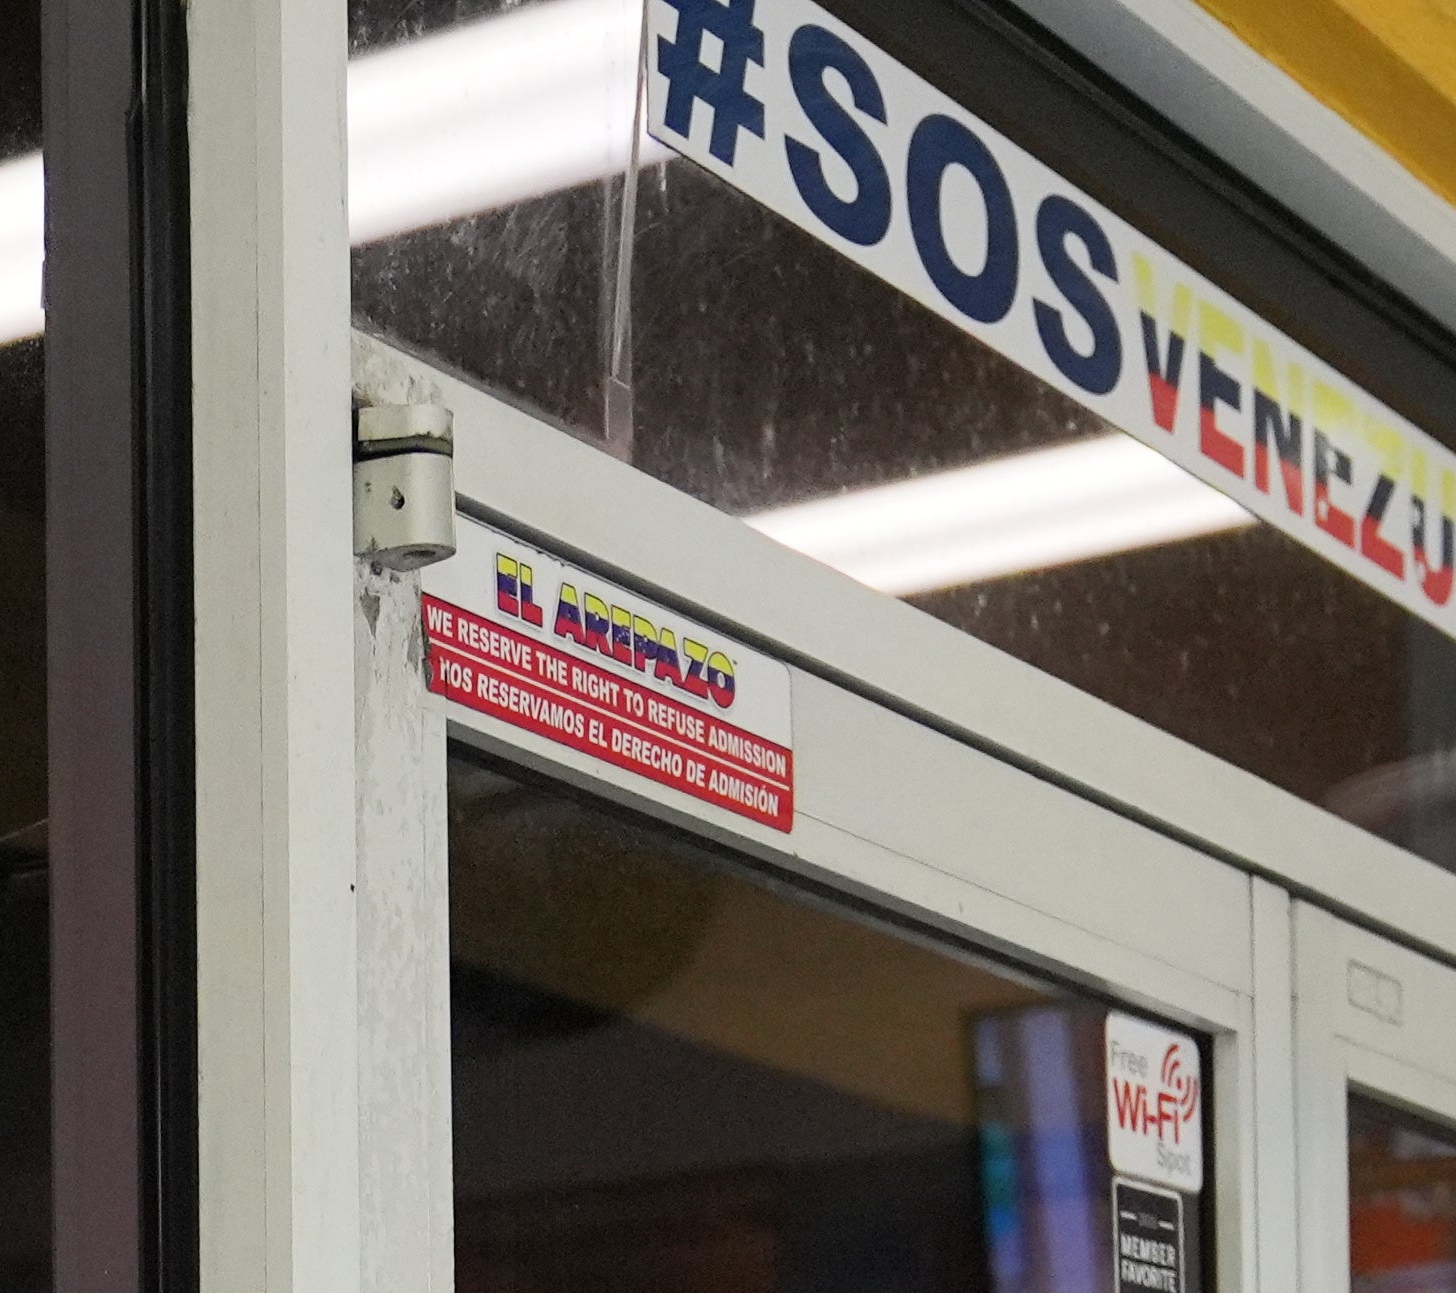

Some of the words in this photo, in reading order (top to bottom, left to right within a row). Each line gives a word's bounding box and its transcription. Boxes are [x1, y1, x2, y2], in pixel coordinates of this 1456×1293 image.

[427, 603, 454, 638] WE
[457, 615, 533, 671] RESERVE
[536, 651, 570, 687] THE
[572, 667, 621, 707] RIGHT
[624, 689, 646, 718] TO
[647, 698, 706, 744] REFUSE
[708, 724, 788, 779] ADMISSION
[495, 551, 544, 629] EL
[554, 581, 738, 709] AREPAZO
[439, 656, 475, 692] NOS
[476, 670, 586, 739] RESERVAMOS
[588, 719, 609, 749] EL
[611, 731, 684, 778] DERECHO
[686, 758, 706, 788] DE
[708, 770, 780, 817] ADMISIÓN
[1112, 1076, 1181, 1145] Wi-Fi
[1120, 1234, 1176, 1267] MEMBER
